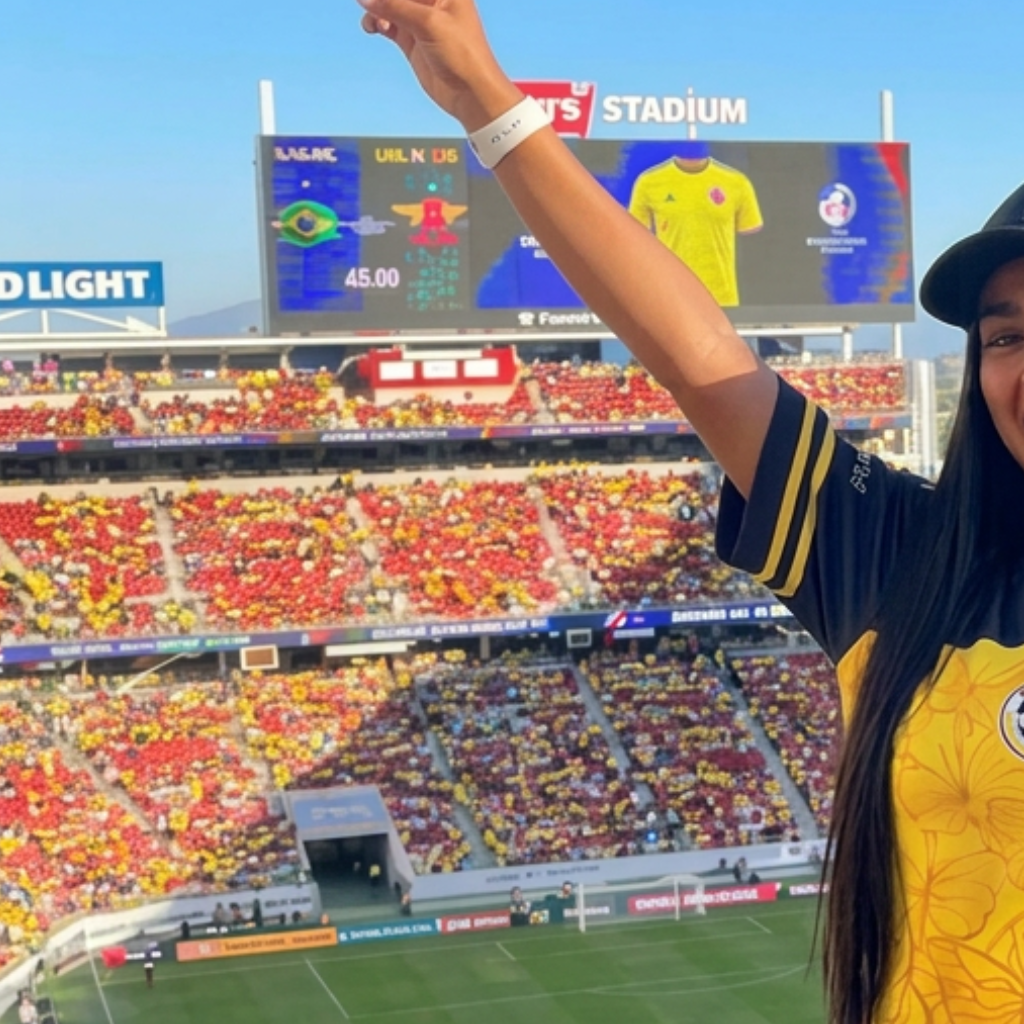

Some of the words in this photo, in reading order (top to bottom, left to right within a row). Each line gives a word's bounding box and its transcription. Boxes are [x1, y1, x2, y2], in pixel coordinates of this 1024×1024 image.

[602, 95, 747, 123] STADIUM
[28, 269, 149, 299] LIGHT
[344, 267, 400, 288] 45.00
